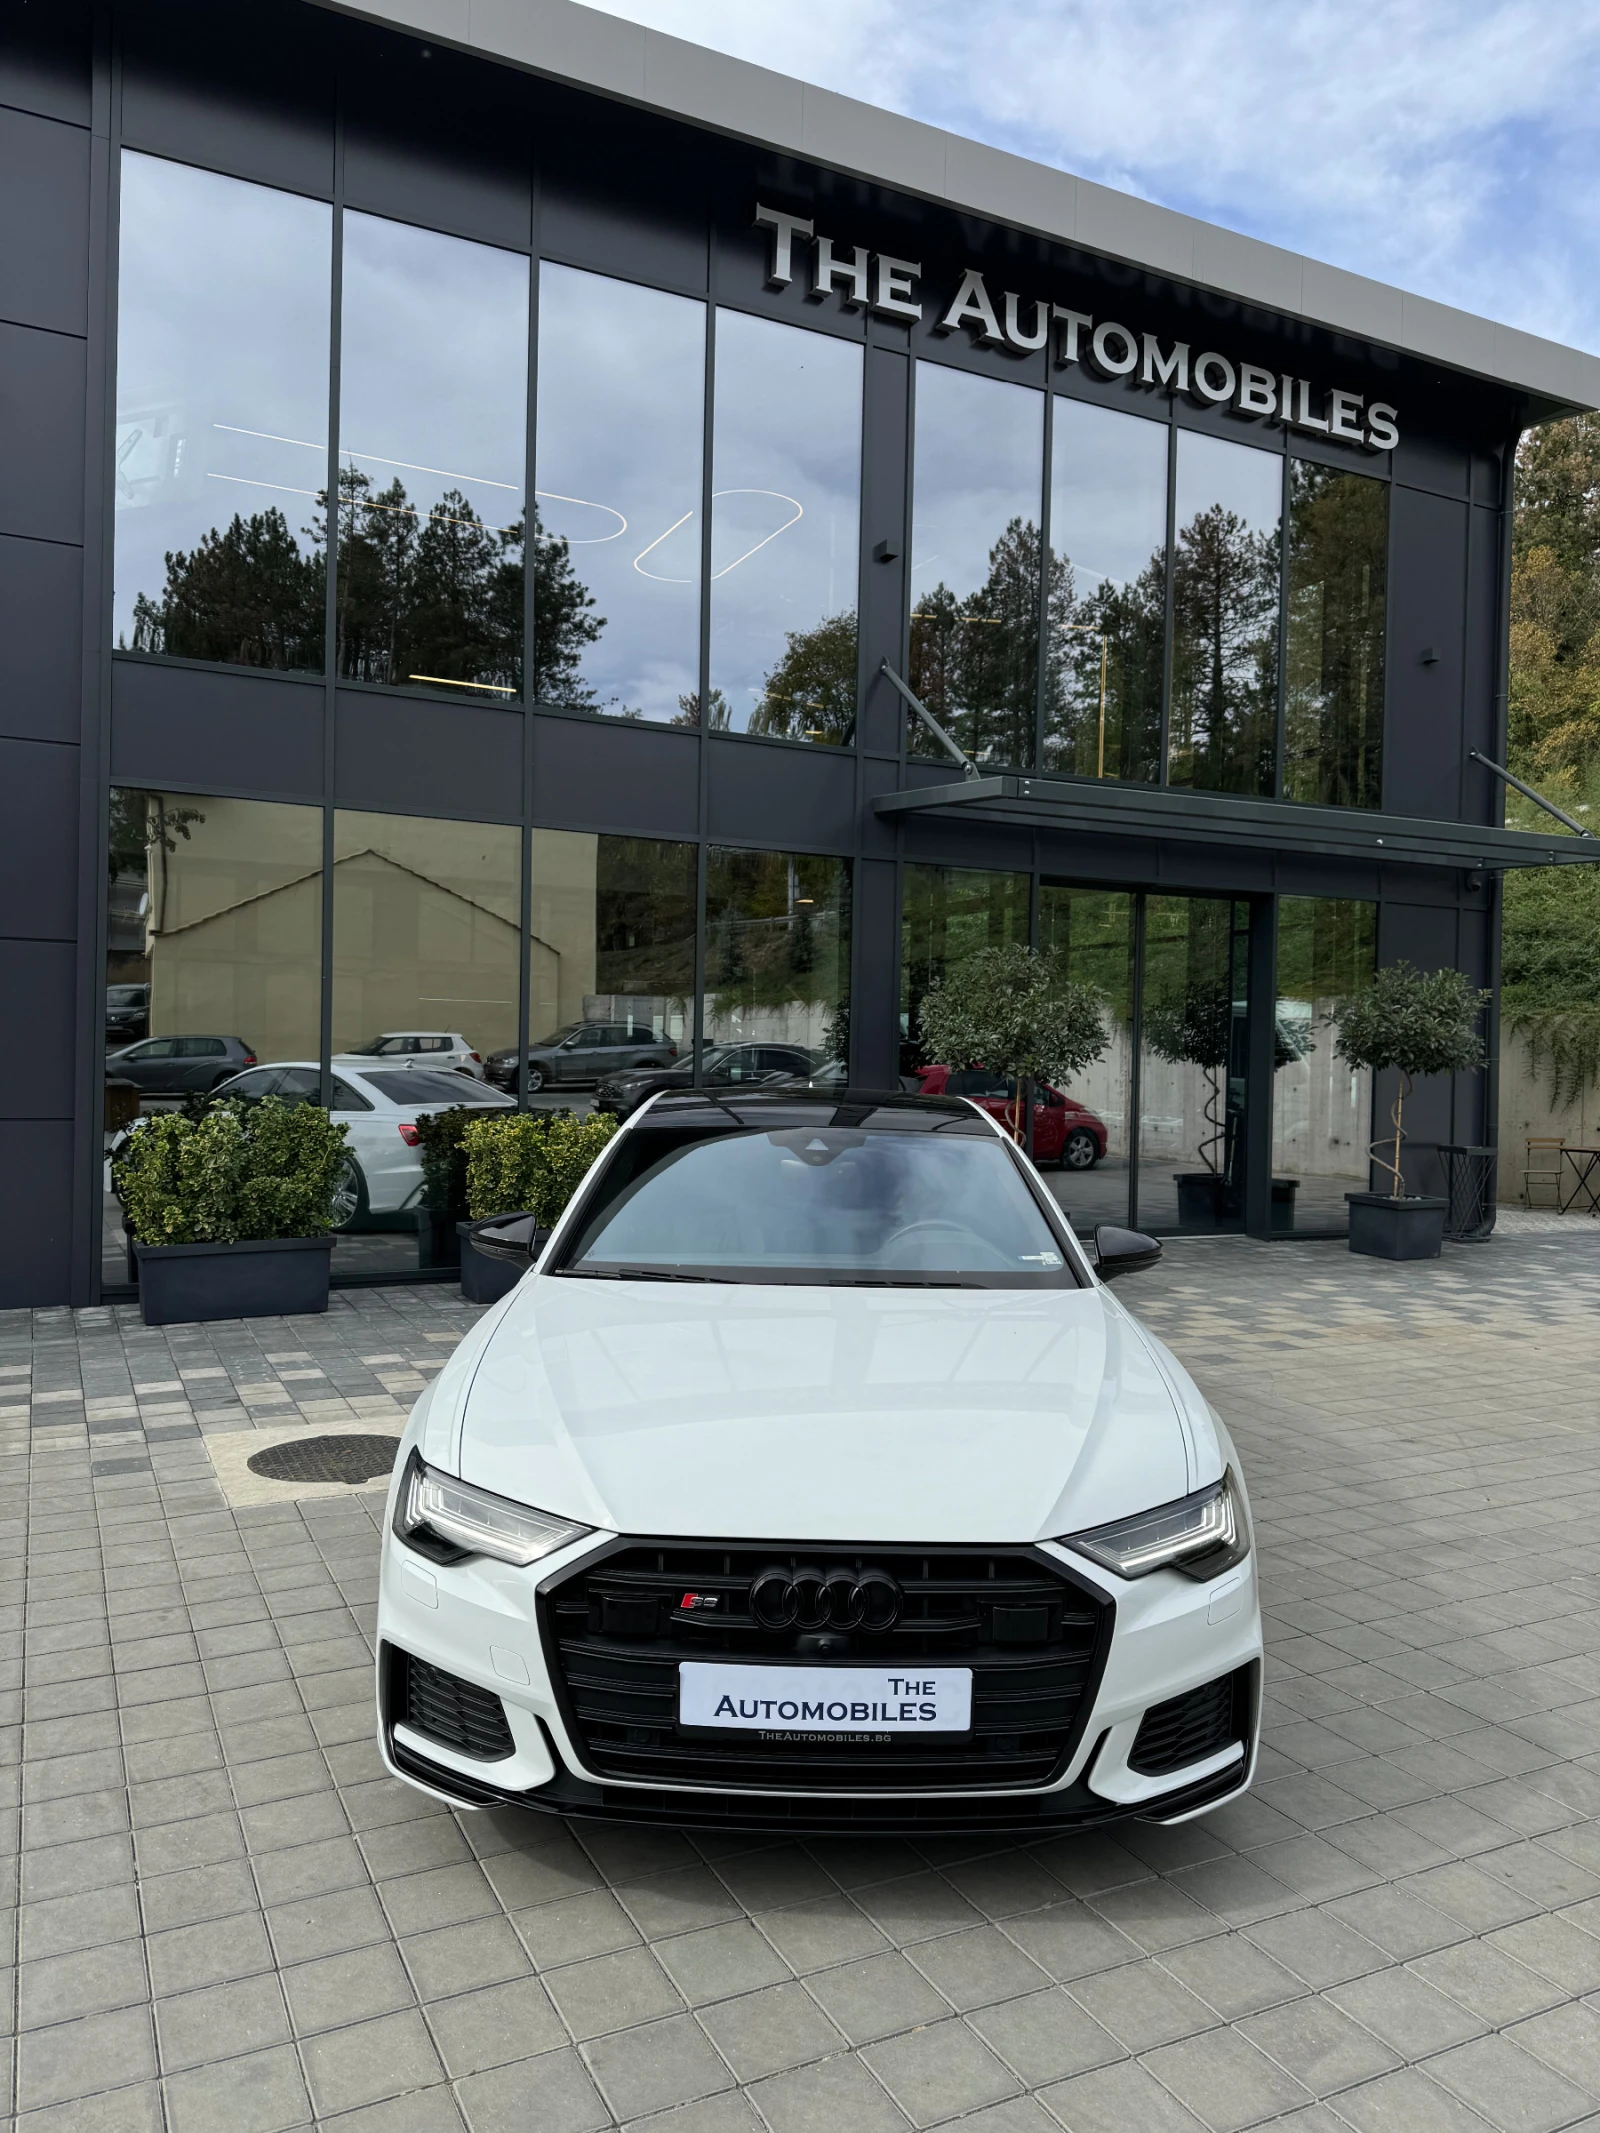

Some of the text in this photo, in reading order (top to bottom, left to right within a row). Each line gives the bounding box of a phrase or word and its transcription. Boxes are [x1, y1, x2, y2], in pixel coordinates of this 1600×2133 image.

[753, 202, 1401, 452] THE AUTOMOBILES
[888, 1678, 936, 1696] THE
[714, 1695, 937, 1722] AUTOMOBILES
